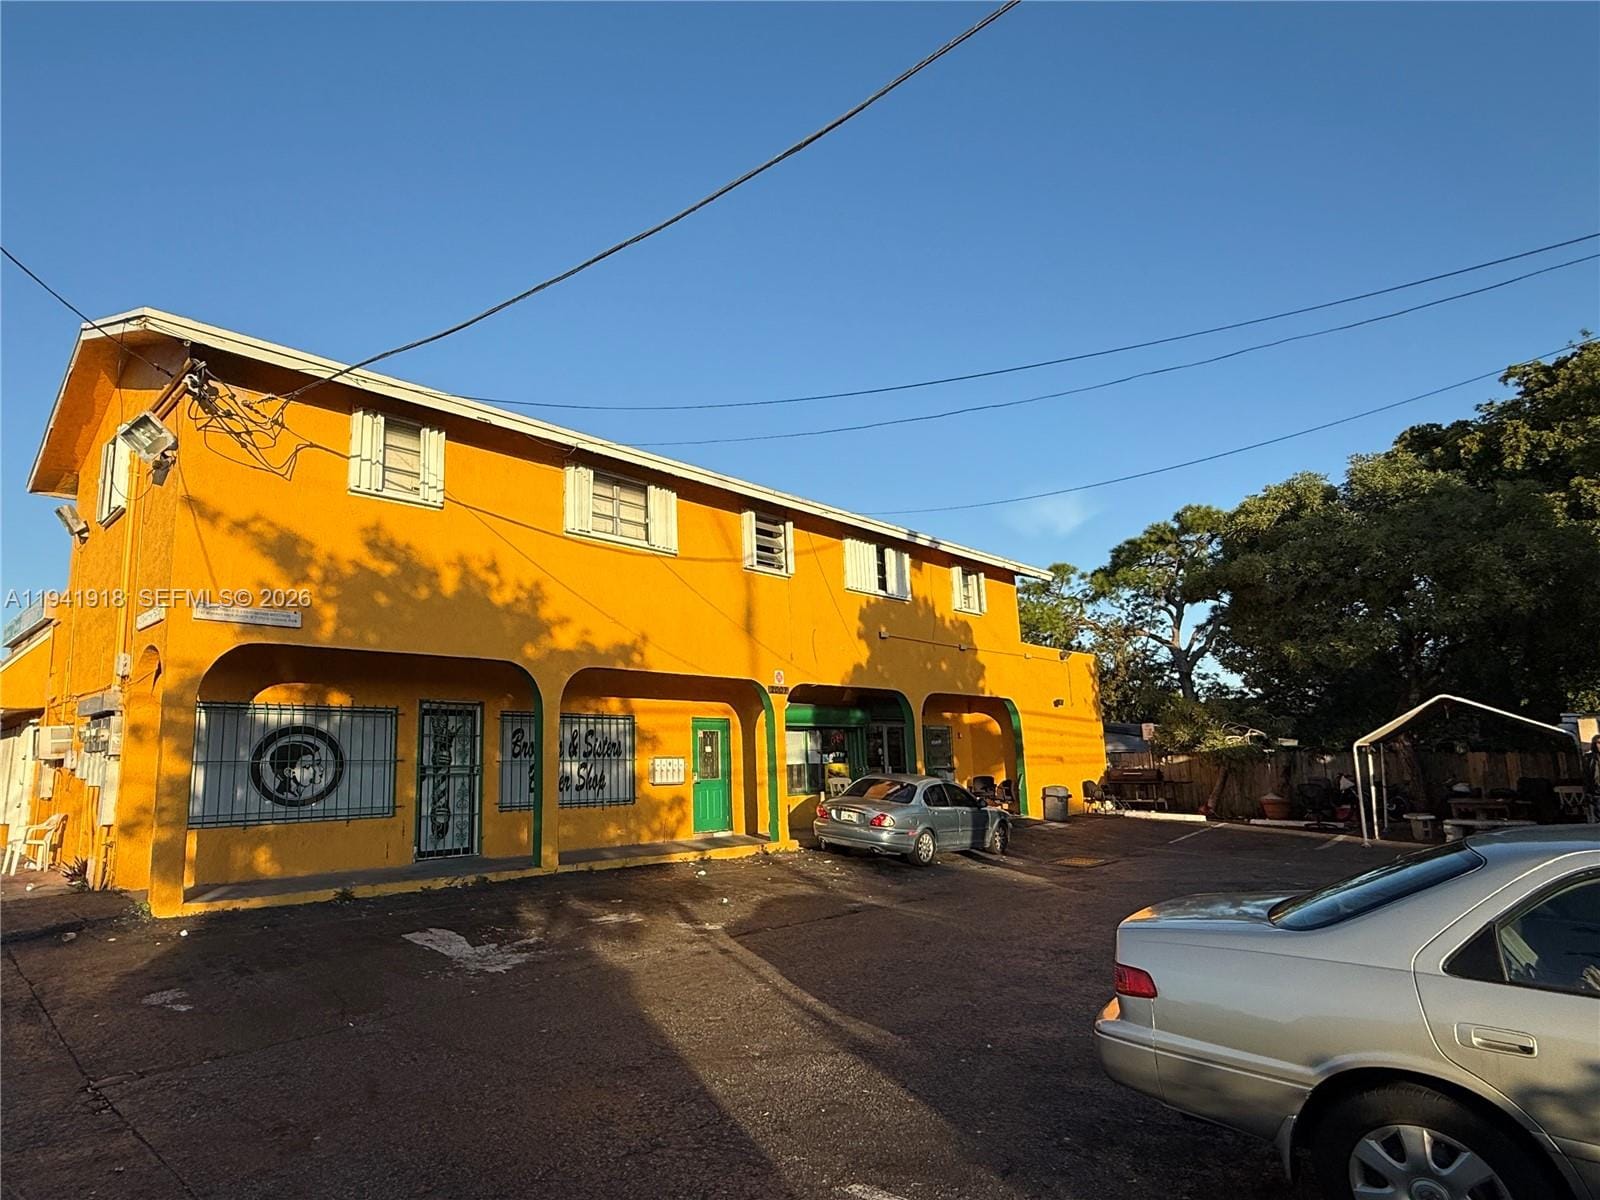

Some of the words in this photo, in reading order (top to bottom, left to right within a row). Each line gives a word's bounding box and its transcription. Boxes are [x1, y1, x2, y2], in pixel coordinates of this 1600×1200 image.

[568, 729, 579, 758] &
[582, 729, 623, 759] Sisters
[575, 762, 607, 798] Shop
